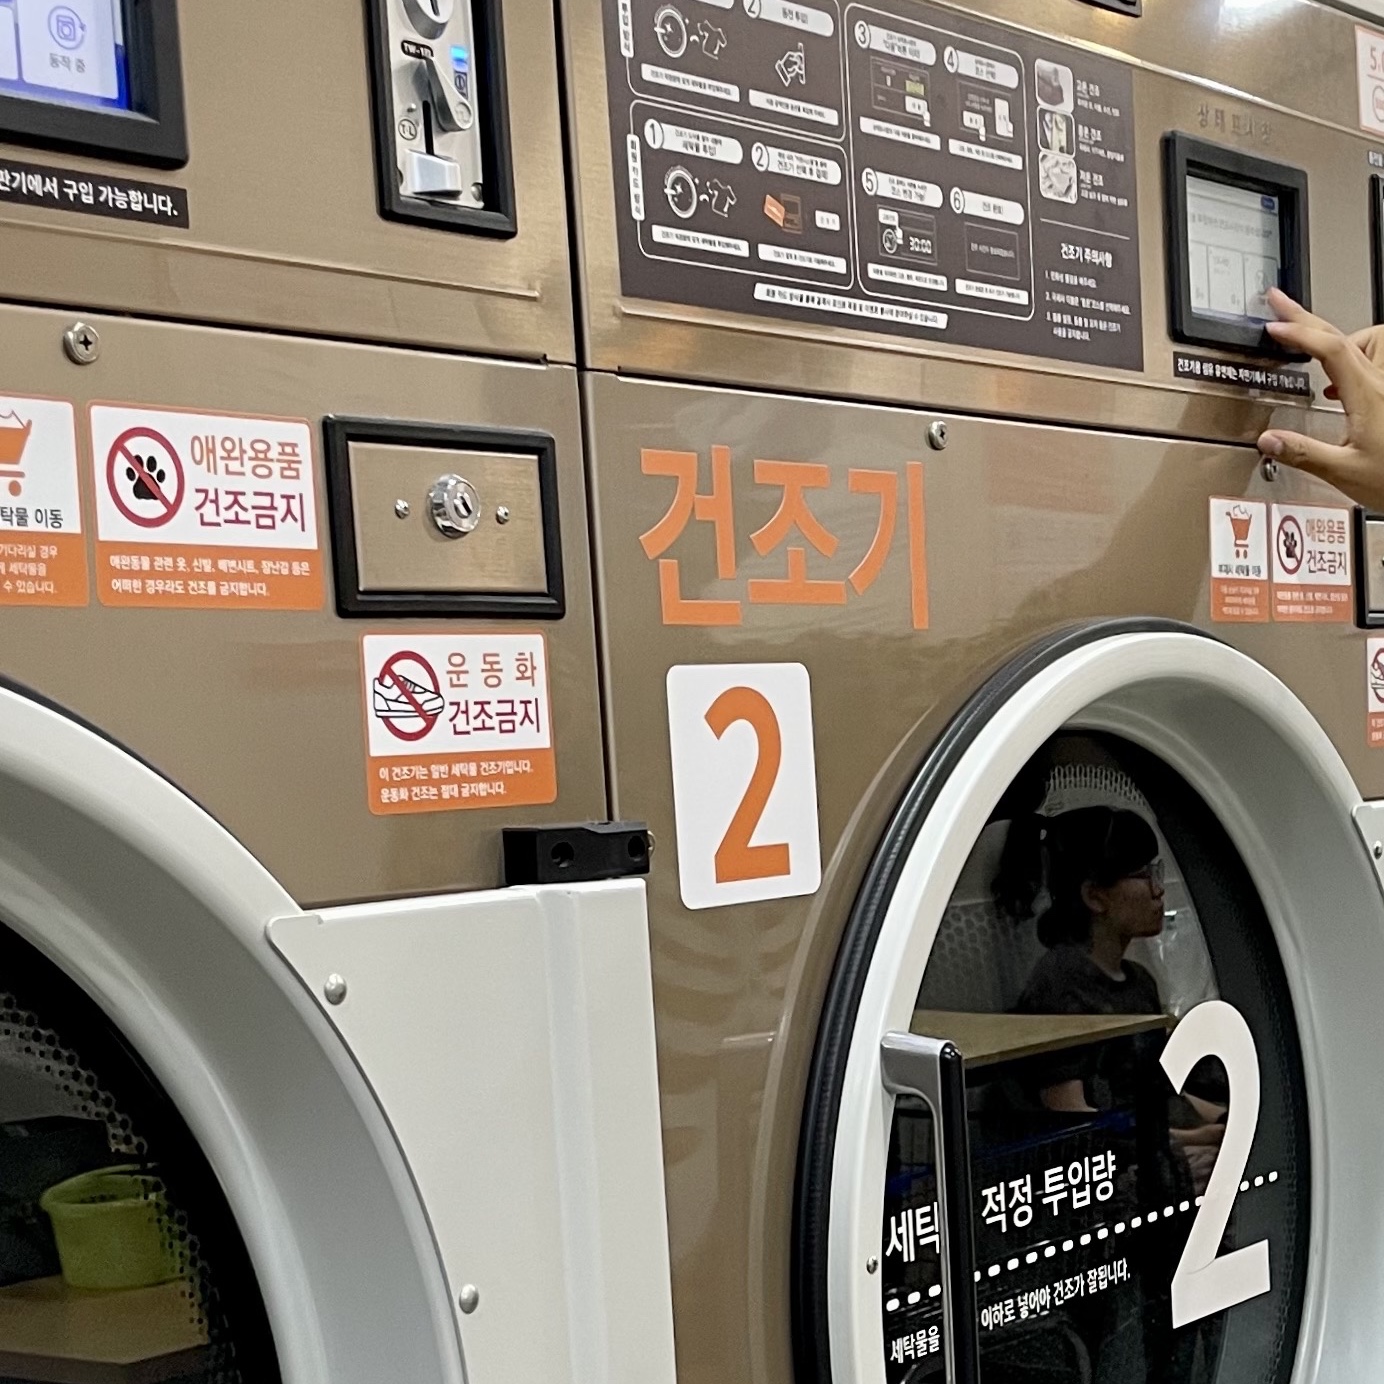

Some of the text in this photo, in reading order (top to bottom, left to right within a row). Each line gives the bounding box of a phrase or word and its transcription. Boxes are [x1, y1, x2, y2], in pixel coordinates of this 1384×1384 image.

[62, 179, 94, 205] 구입
[98, 185, 179, 216] 가능합니다.
[190, 434, 303, 480] 애완용품
[35, 508, 64, 530] 이동
[194, 487, 306, 533] 건조금지
[639, 444, 929, 630] 건조기
[1306, 518, 1346, 544] 애완용품
[40, 545, 58, 560] 경우
[1306, 549, 1347, 576] 건조금지
[448, 698, 541, 736] 건조금지
[379, 767, 390, 782] 이
[392, 766, 429, 781] 건조기는
[430, 763, 449, 780] 일반
[451, 762, 478, 777] 세탁물
[704, 686, 791, 884] 2
[380, 788, 409, 804] 운동화
[410, 786, 439, 801] 건조는
[1159, 999, 1271, 1330] 2
[981, 1174, 1033, 1233] 적정
[1042, 1150, 1117, 1216] 투입량
[890, 1257, 1131, 1364] 세탁물을 이하로 넣어야 건조가 잘됩니다.
